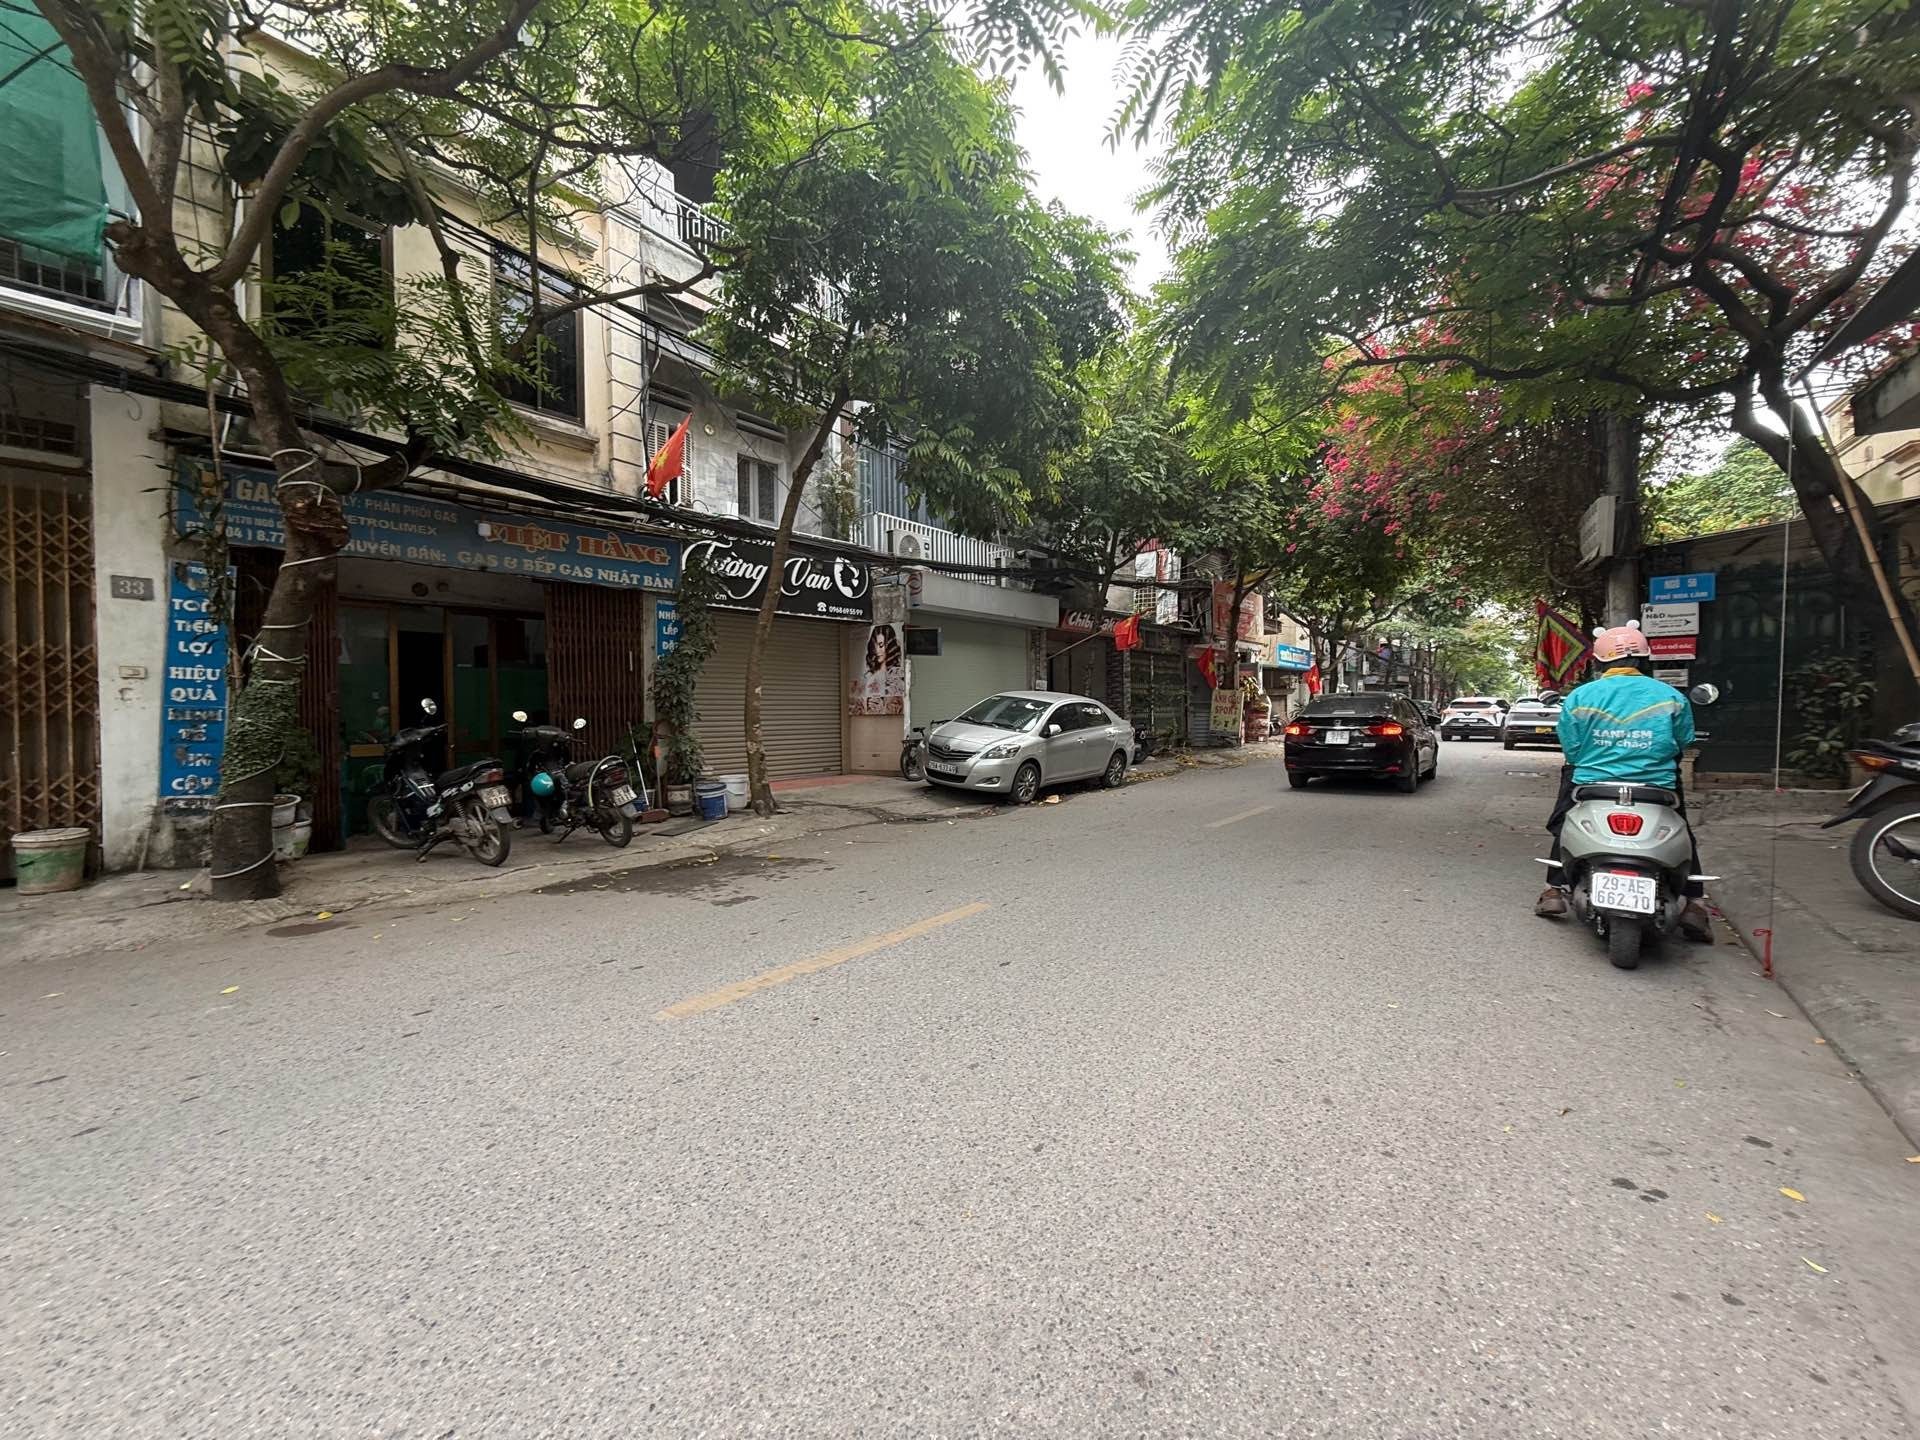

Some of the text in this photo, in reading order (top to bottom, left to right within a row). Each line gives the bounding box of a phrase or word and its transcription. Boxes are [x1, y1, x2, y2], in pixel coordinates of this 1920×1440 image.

[457, 551, 498, 568] GAS
[523, 556, 556, 574] BẾP
[560, 563, 593, 579] GAS
[597, 569, 640, 587] NHẬT
[643, 573, 674, 589] BẢN
[119, 580, 145, 595] 33
[168, 664, 222, 683] HIỆU
[170, 684, 218, 703] QUẢ
[1602, 876, 1645, 895] 29-AE
[1598, 891, 1650, 910] 662.10
